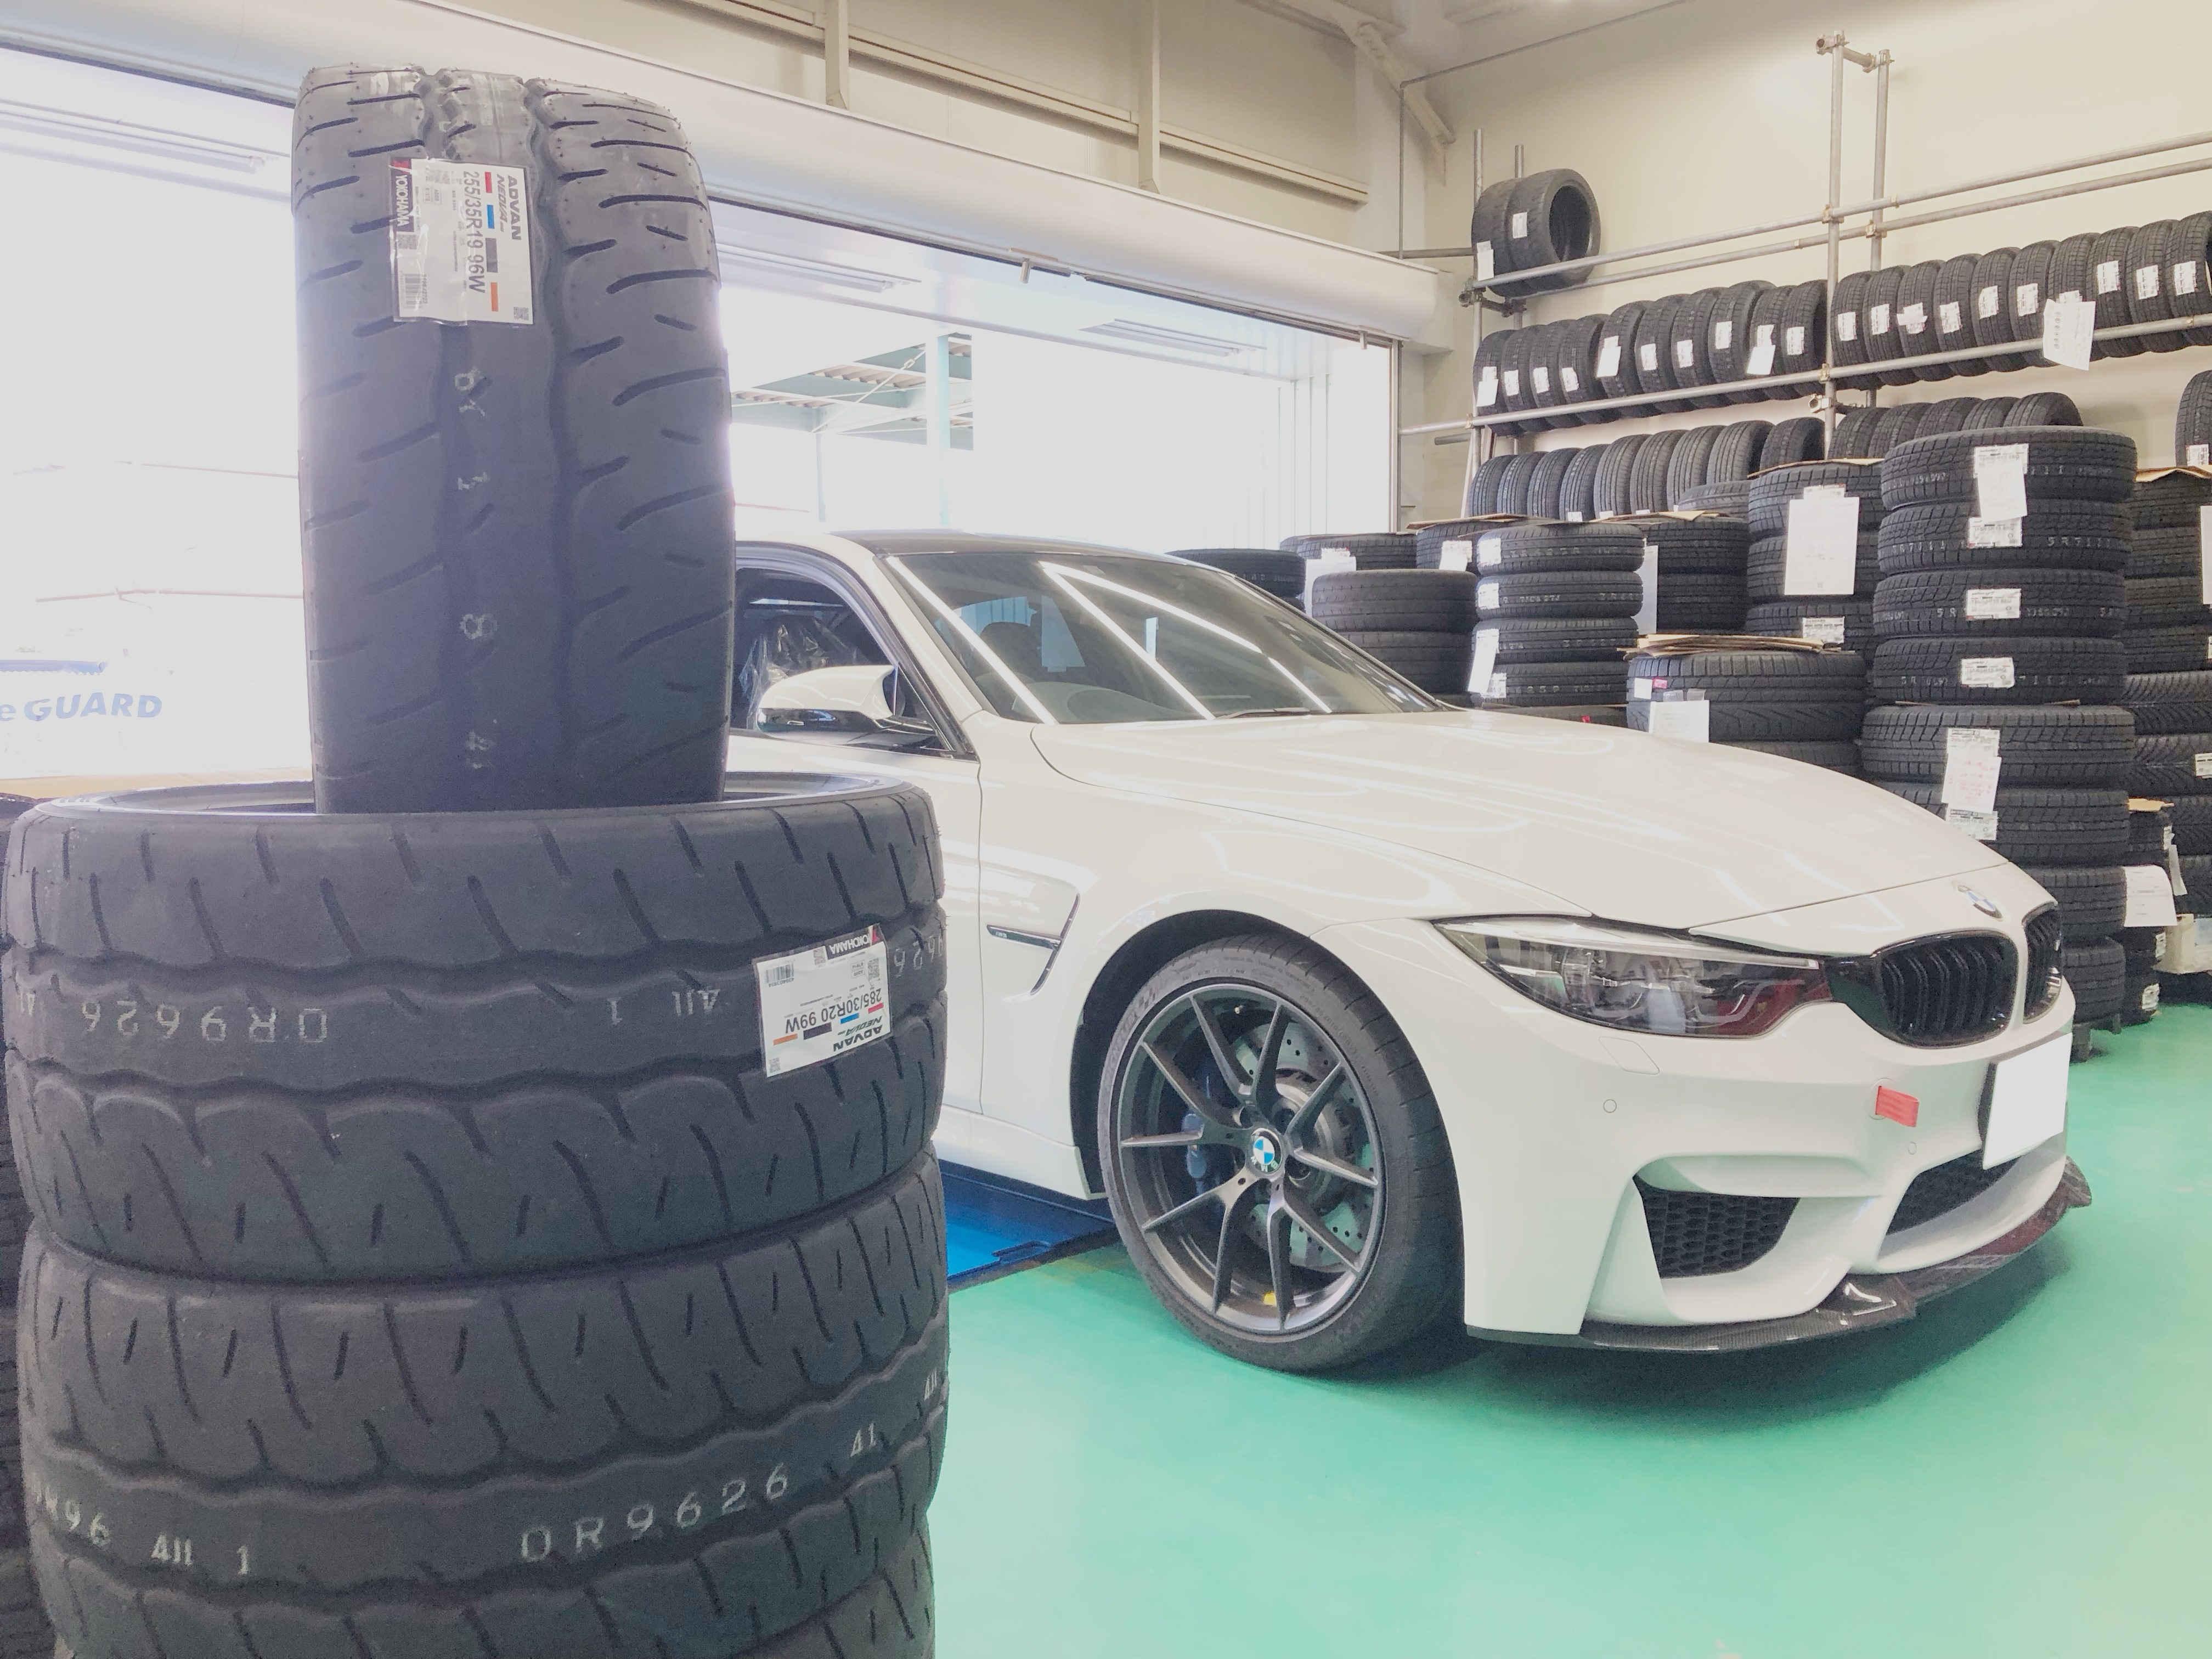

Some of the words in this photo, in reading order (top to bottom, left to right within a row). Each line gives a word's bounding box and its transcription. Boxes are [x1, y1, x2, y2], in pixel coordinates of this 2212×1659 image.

[395, 174, 410, 227] YOKOHAMA
[464, 171, 483, 249] 255/35R19
[496, 174, 507, 222] NEOVA
[508, 175, 522, 240] ADVAN
[467, 255, 486, 293] 96W
[821, 988, 882, 1022] 285/30R20
[785, 1015, 817, 1034] 99W
[833, 1025, 882, 1052] ADVAN
[845, 1015, 882, 1037] NEOVA
